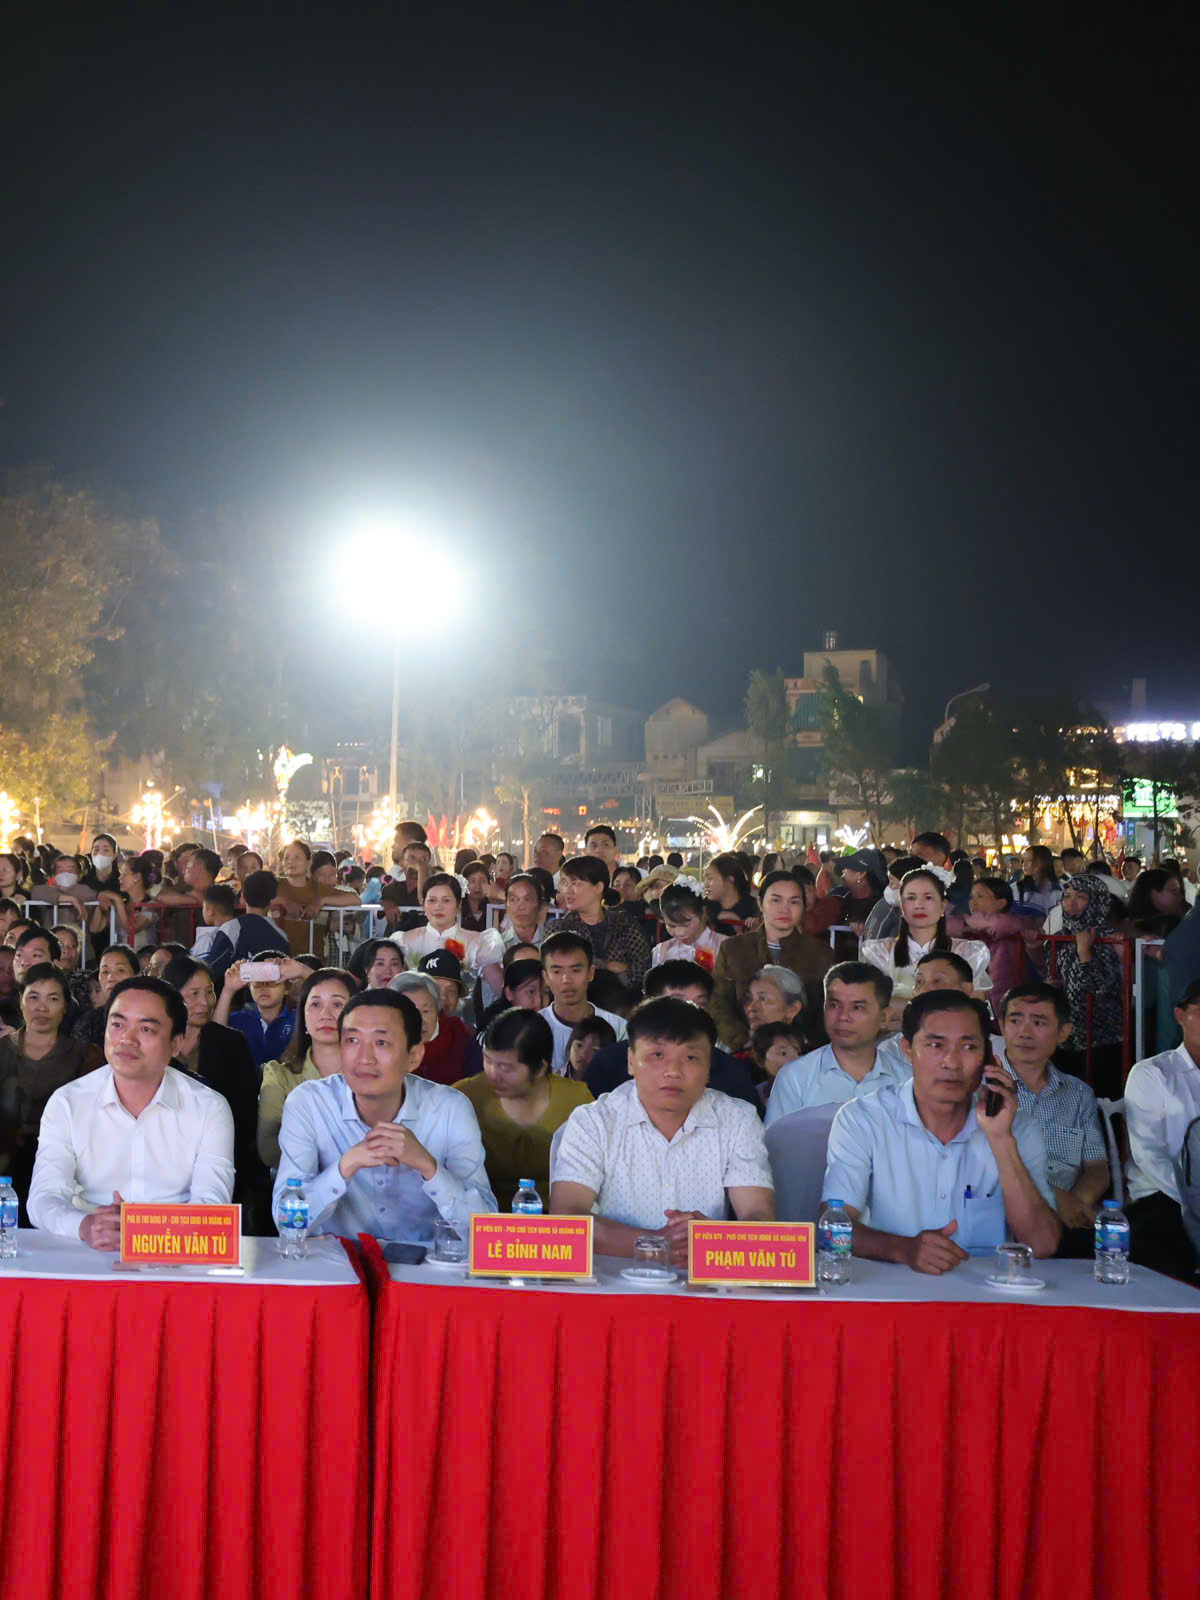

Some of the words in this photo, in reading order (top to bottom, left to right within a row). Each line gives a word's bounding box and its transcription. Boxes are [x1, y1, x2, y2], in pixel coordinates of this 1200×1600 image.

[132, 1228, 180, 1254] NGUYỄN
[184, 1232, 208, 1254] VĂN
[212, 1232, 227, 1255] TÚ
[488, 1240, 503, 1258] LÊ
[542, 1244, 572, 1260] NAM
[706, 1250, 745, 1270] PHẠM
[749, 1249, 776, 1268] VĂN
[780, 1249, 796, 1268] TÚ
